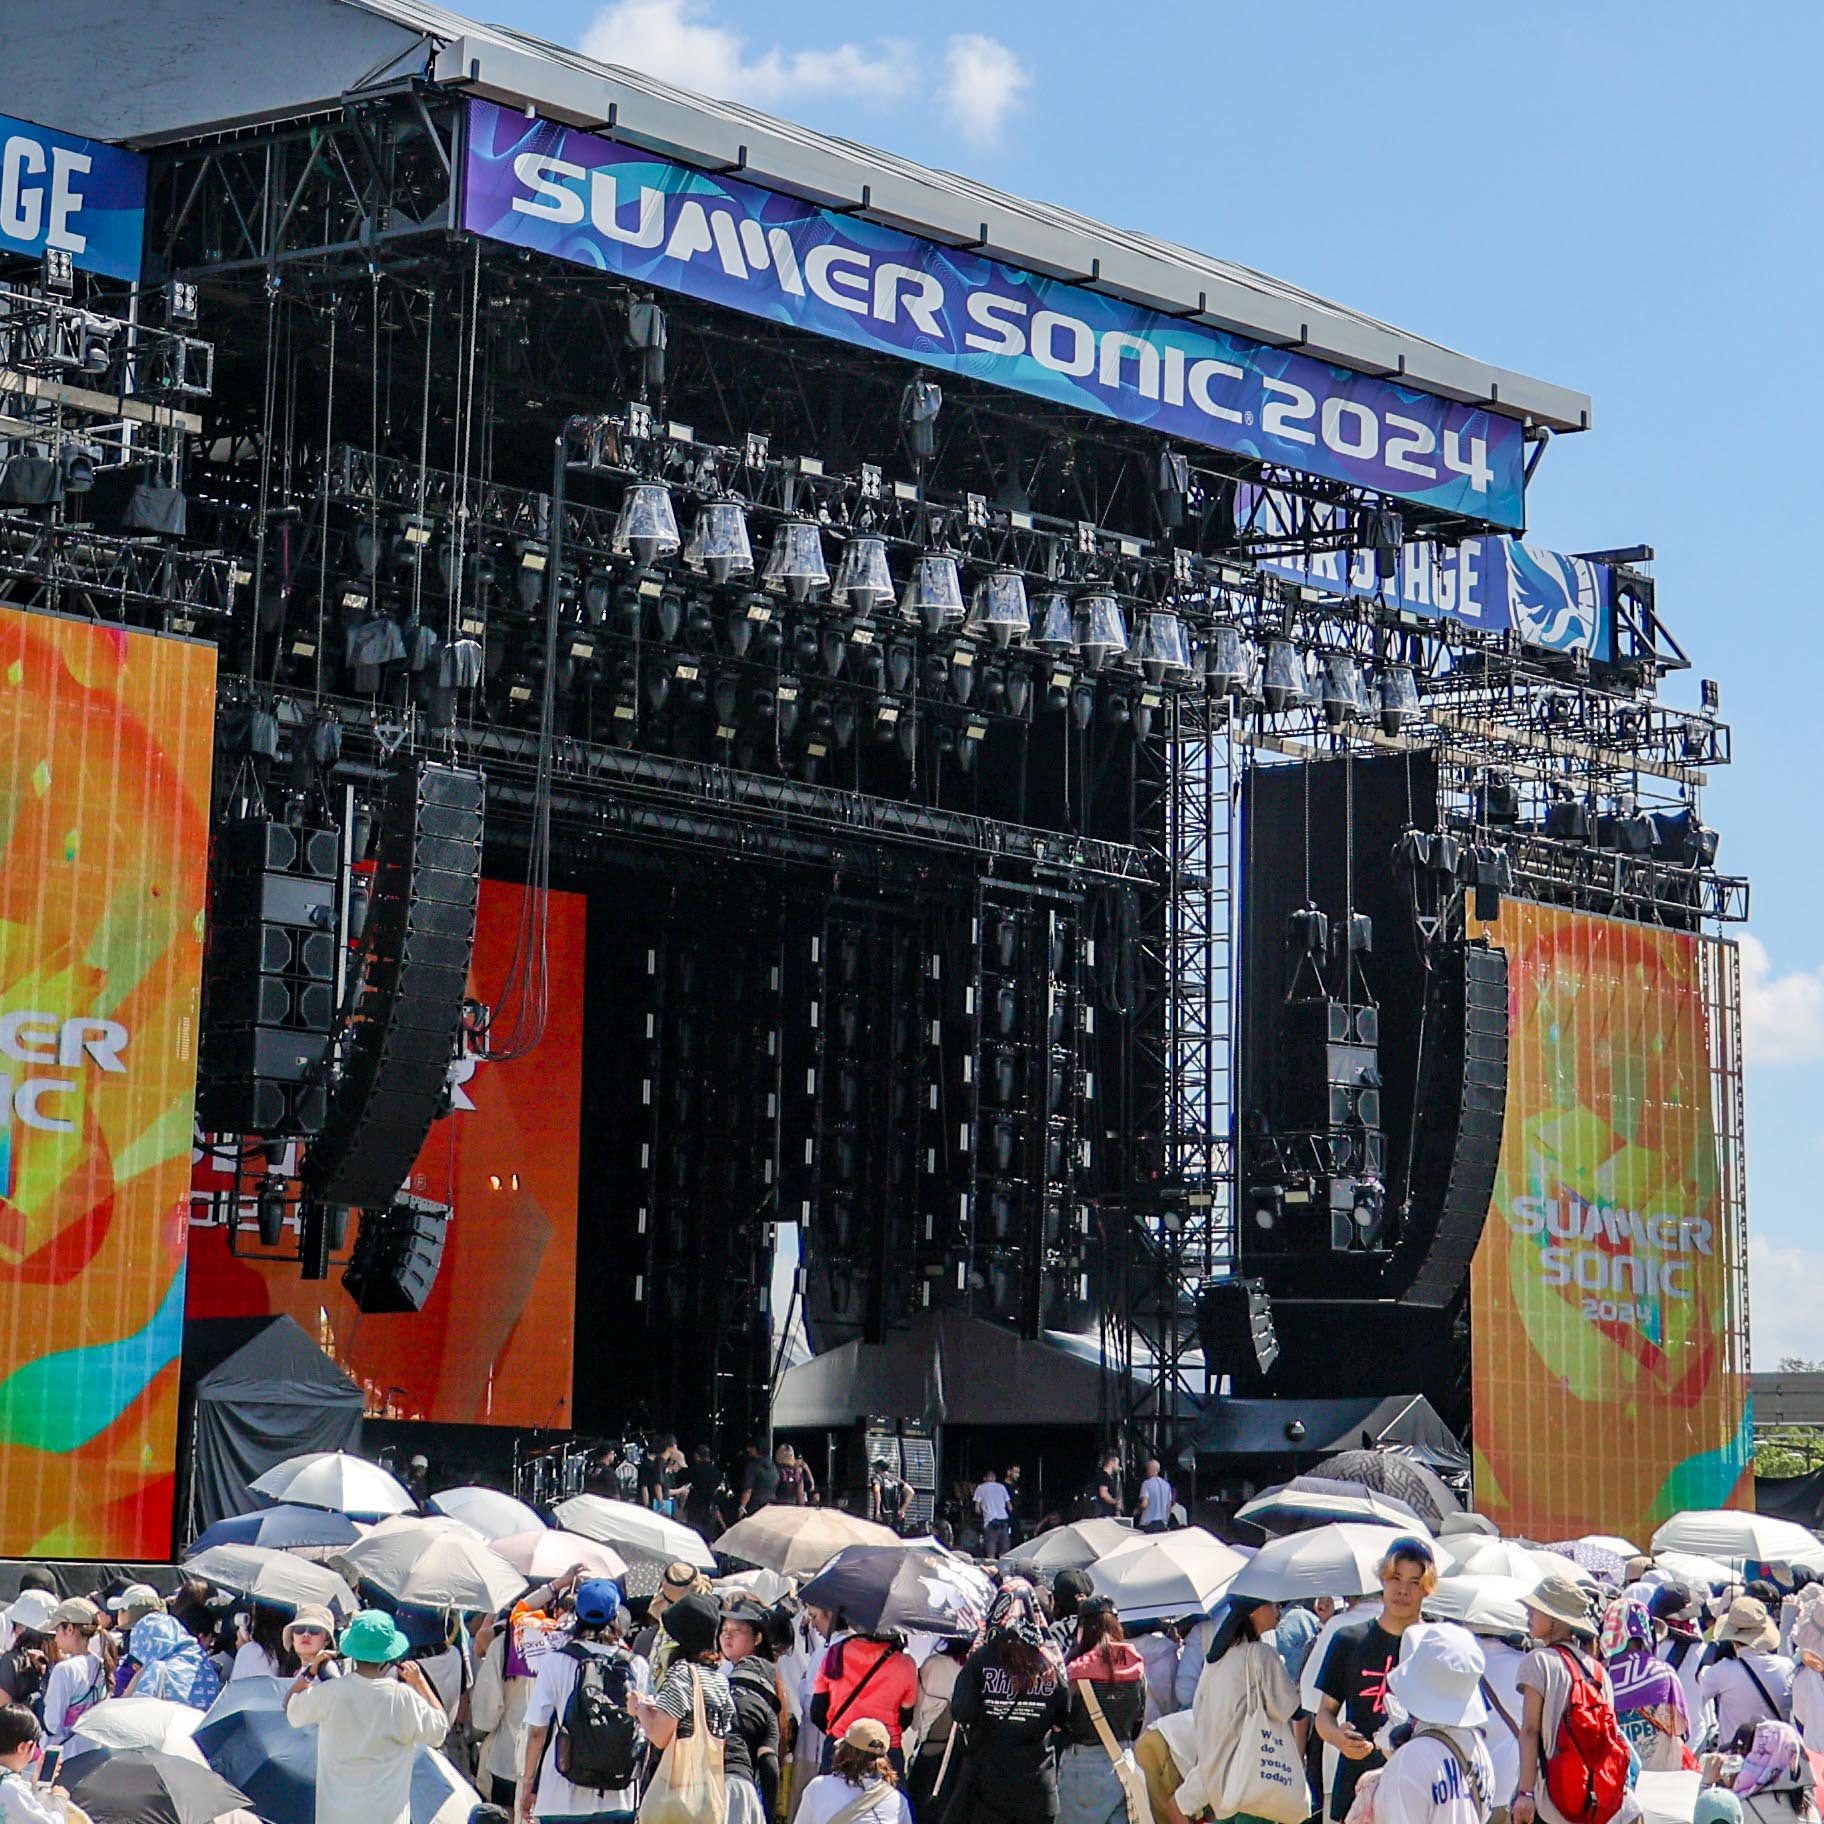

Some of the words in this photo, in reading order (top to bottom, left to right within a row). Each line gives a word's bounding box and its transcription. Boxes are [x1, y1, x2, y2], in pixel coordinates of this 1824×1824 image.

[512, 150, 945, 338] SUMMER
[964, 301, 1246, 424] SONIC
[1262, 379, 1495, 493] 2024
[1511, 1196, 1713, 1256] SUMMER
[1541, 1246, 1690, 1299] SONIC
[1582, 1297, 1652, 1324] 2024
[1260, 1744, 1275, 1754] do
[1261, 1729, 1283, 1746] Wt
[1260, 1758, 1281, 1768] you
